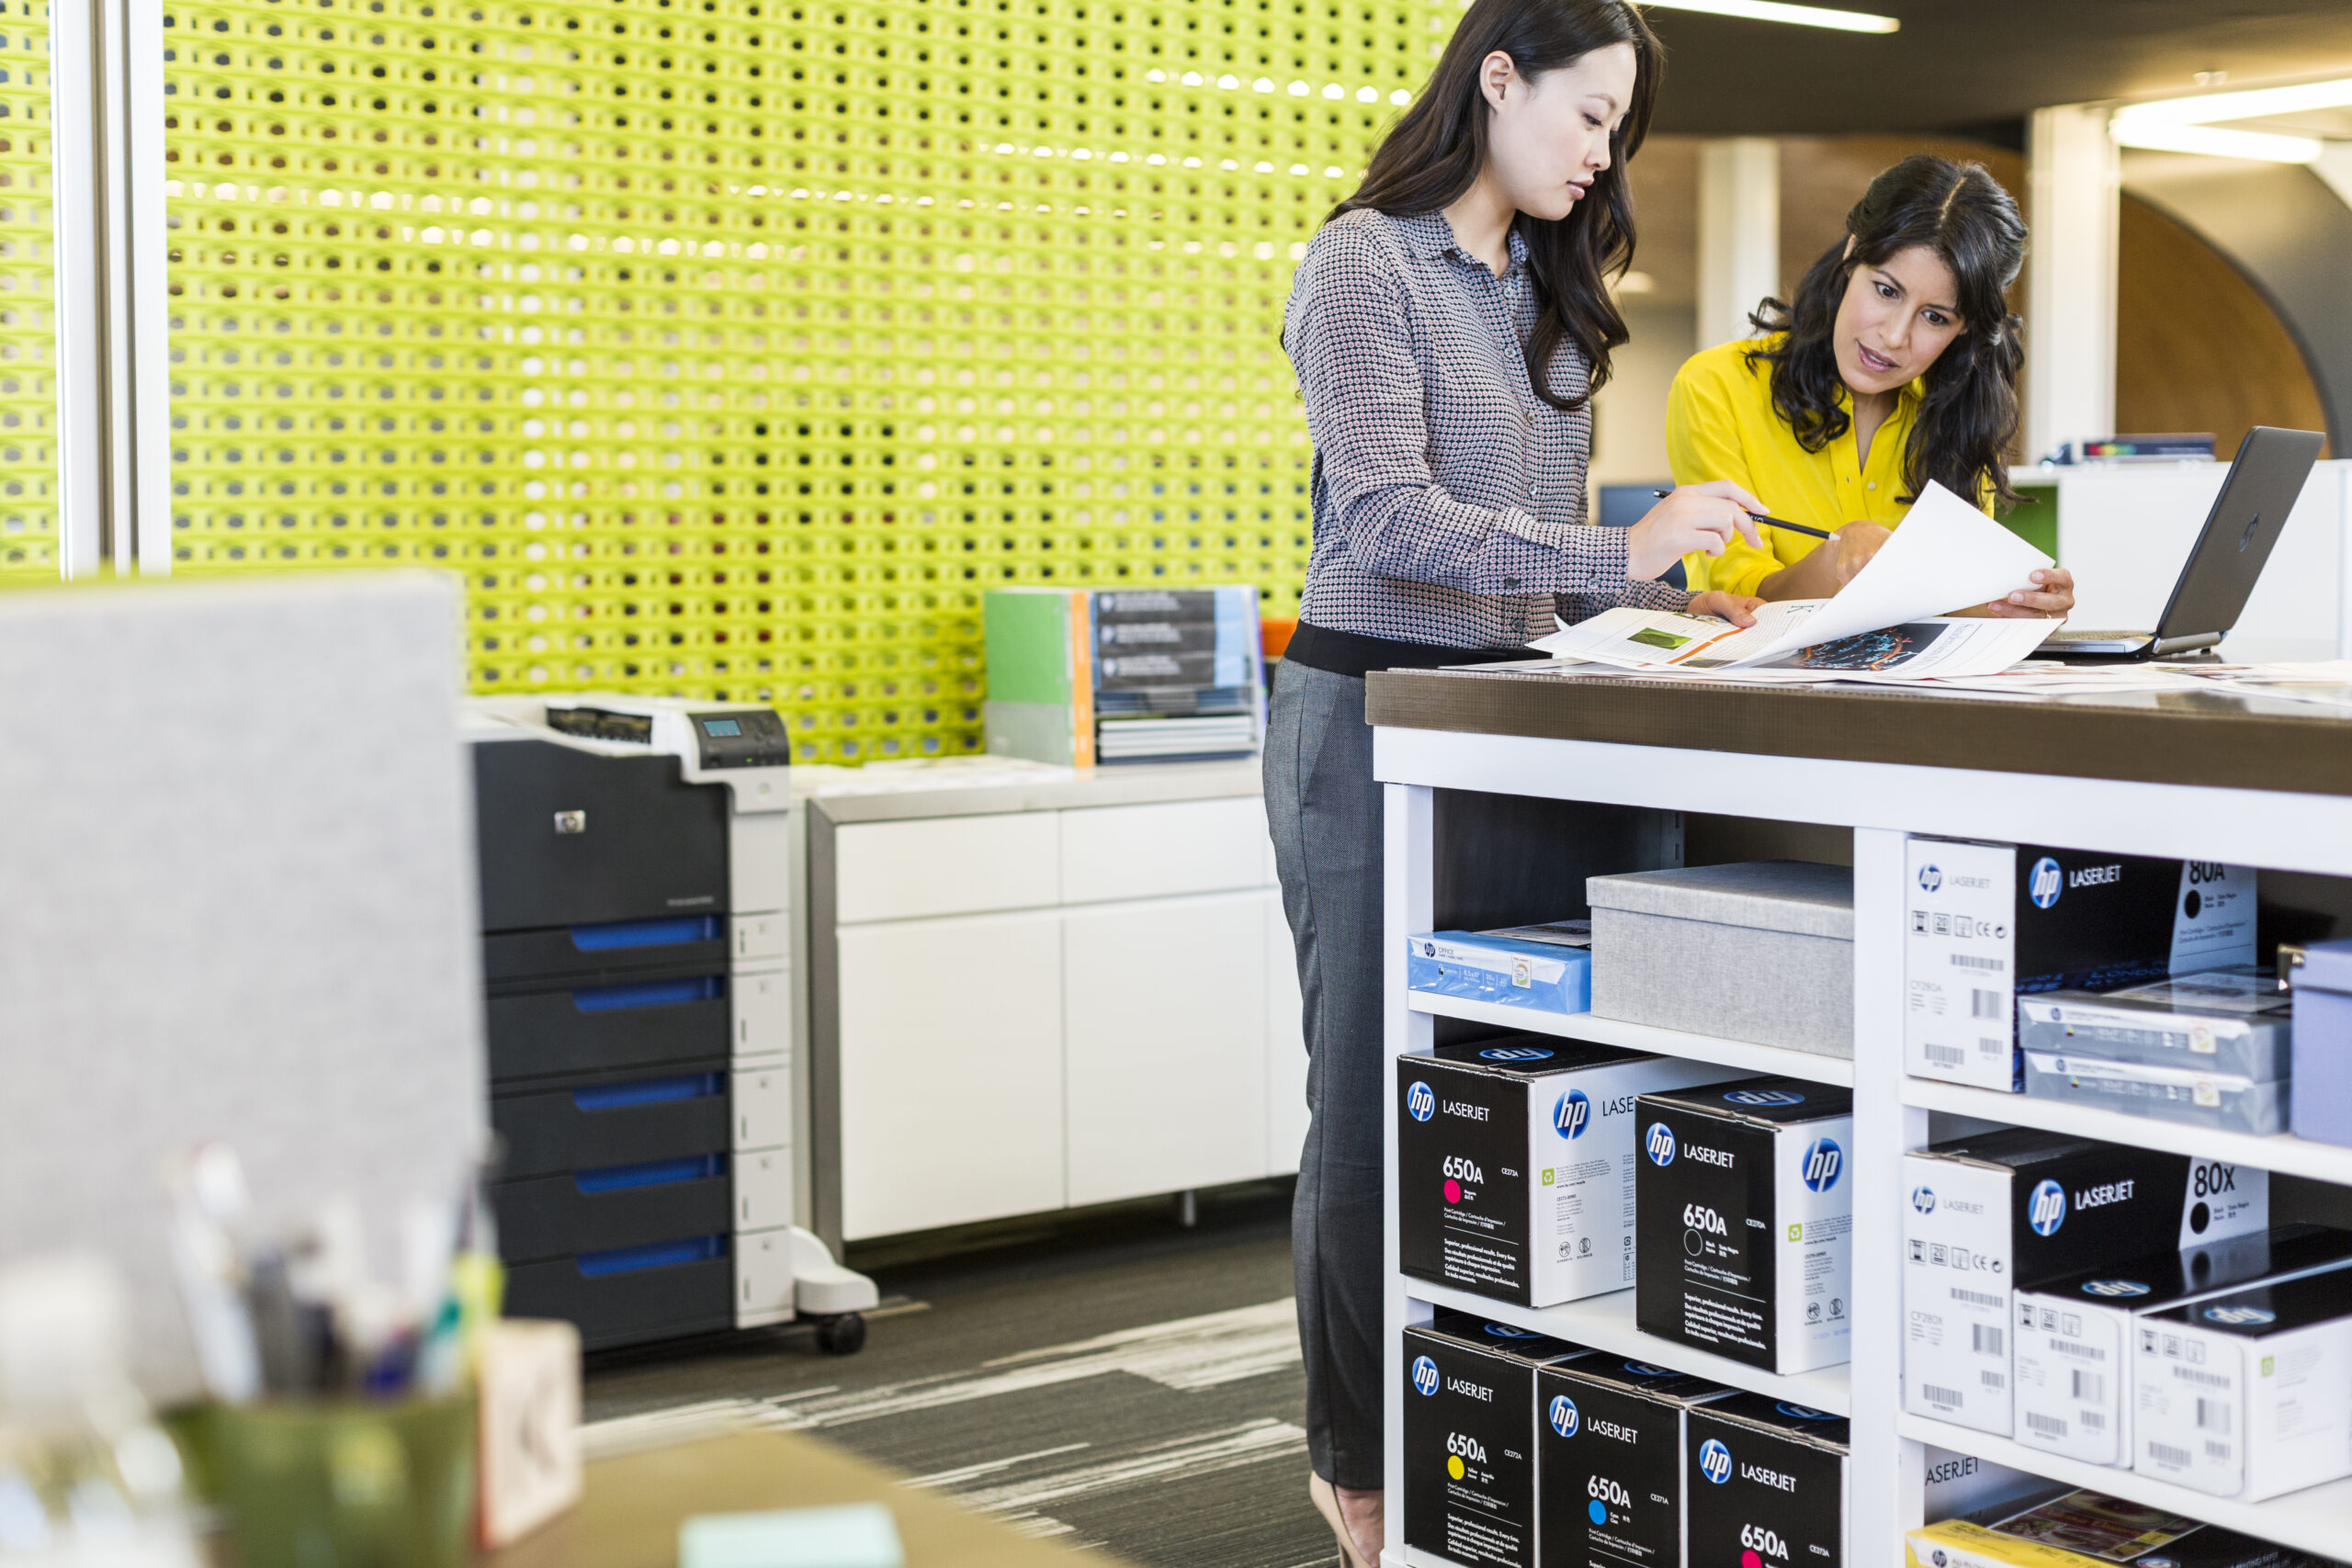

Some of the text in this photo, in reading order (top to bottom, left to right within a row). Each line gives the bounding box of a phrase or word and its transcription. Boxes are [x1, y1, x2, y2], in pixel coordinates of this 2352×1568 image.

[1918, 863, 1991, 893] hp LASERJET
[2031, 857, 2122, 908] hp LASERJET
[1424, 942, 1436, 958] hp
[1409, 1081, 1489, 1122] hp LASERJET
[1555, 1089, 1634, 1140] hp LASE
[1648, 1122, 1735, 1168] hp LASERJET
[1804, 1137, 1841, 1192] hp
[1442, 1156, 1484, 1184] 650A
[2195, 1162, 2235, 1198] 80X
[1683, 1203, 1727, 1235] 650A
[1913, 1185, 1984, 1215] hp LASERJET
[2031, 1179, 2134, 1235] hp LASERJET
[1414, 1356, 1493, 1403] hp LASERJET
[1552, 1395, 1638, 1445] hp LASERJET
[1447, 1432, 1487, 1463] 650A
[1702, 1438, 1796, 1493] hp LASERJET
[1588, 1475, 1668, 1508] 650A CE271A
[1740, 1524, 1789, 1561] 650A
